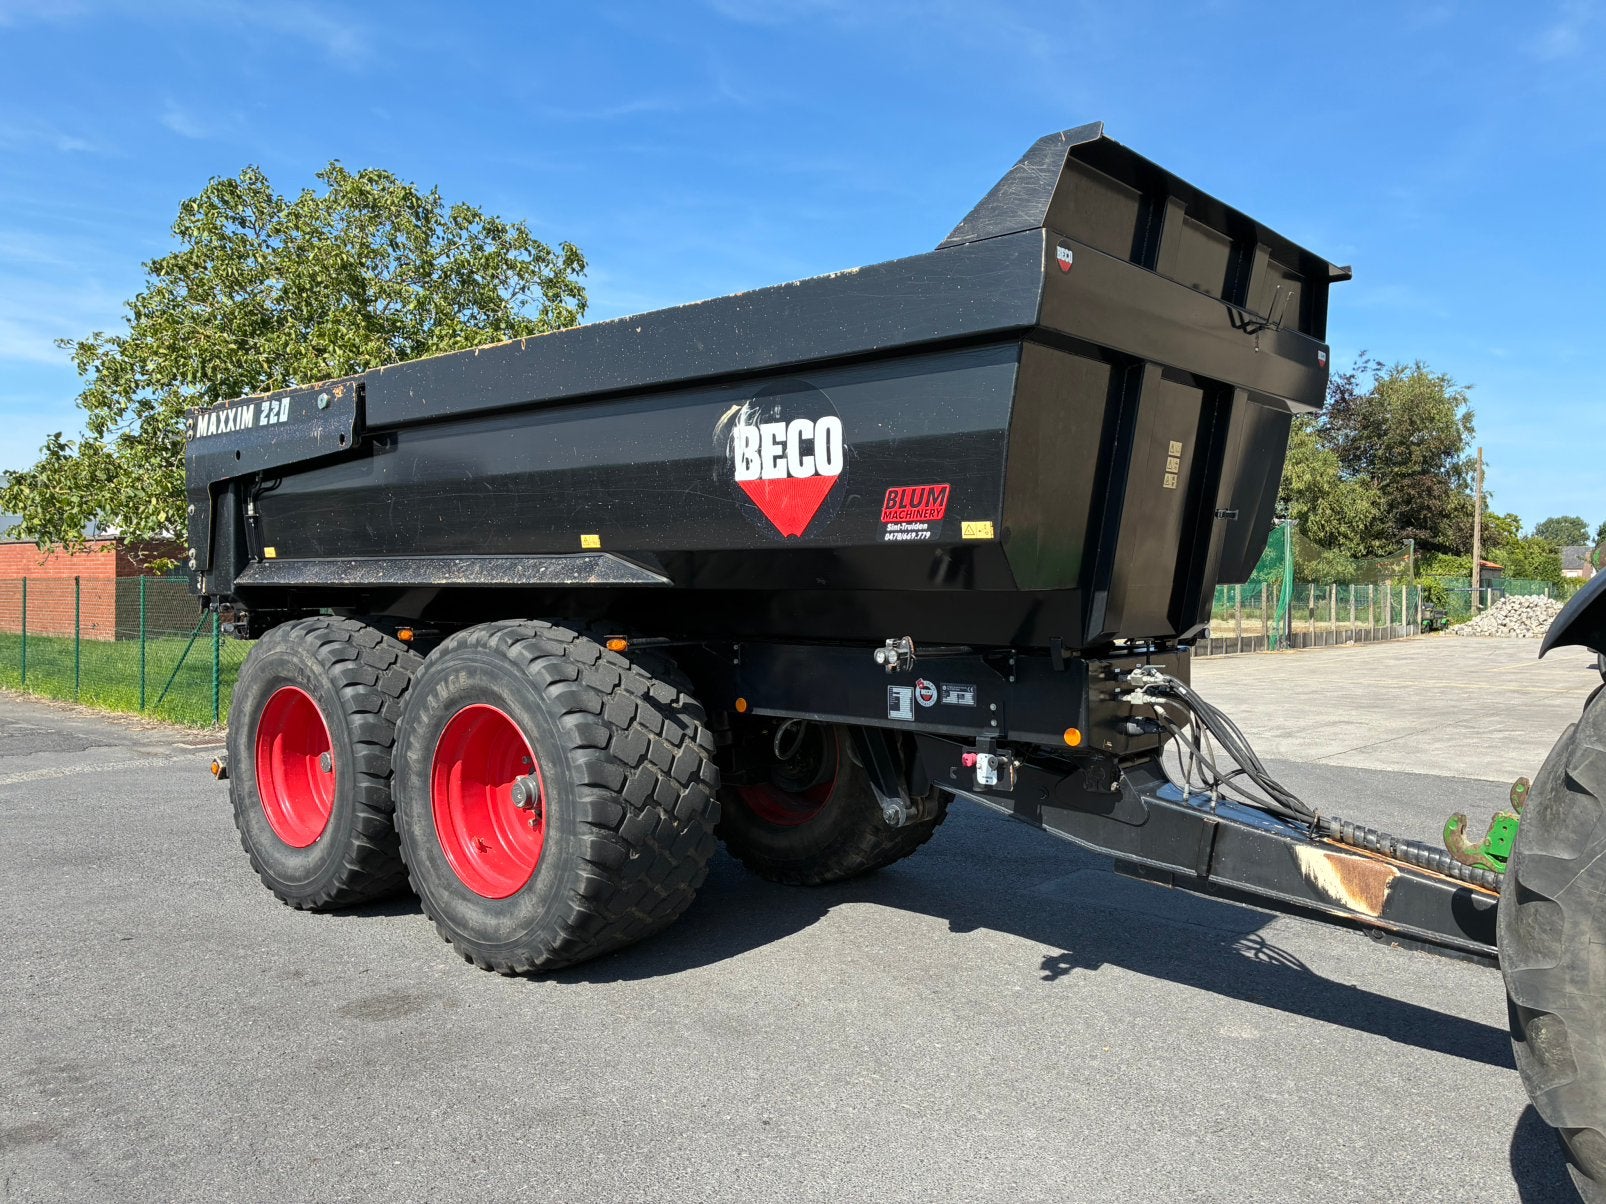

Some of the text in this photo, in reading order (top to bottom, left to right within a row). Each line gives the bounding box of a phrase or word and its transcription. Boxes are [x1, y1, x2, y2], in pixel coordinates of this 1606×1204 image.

[196, 397, 290, 438] MAXXIM 220
[734, 416, 844, 481] BECO
[885, 487, 948, 509] BLUM
[882, 508, 942, 520] MACHINERY
[886, 522, 928, 531] Sint-Truiden
